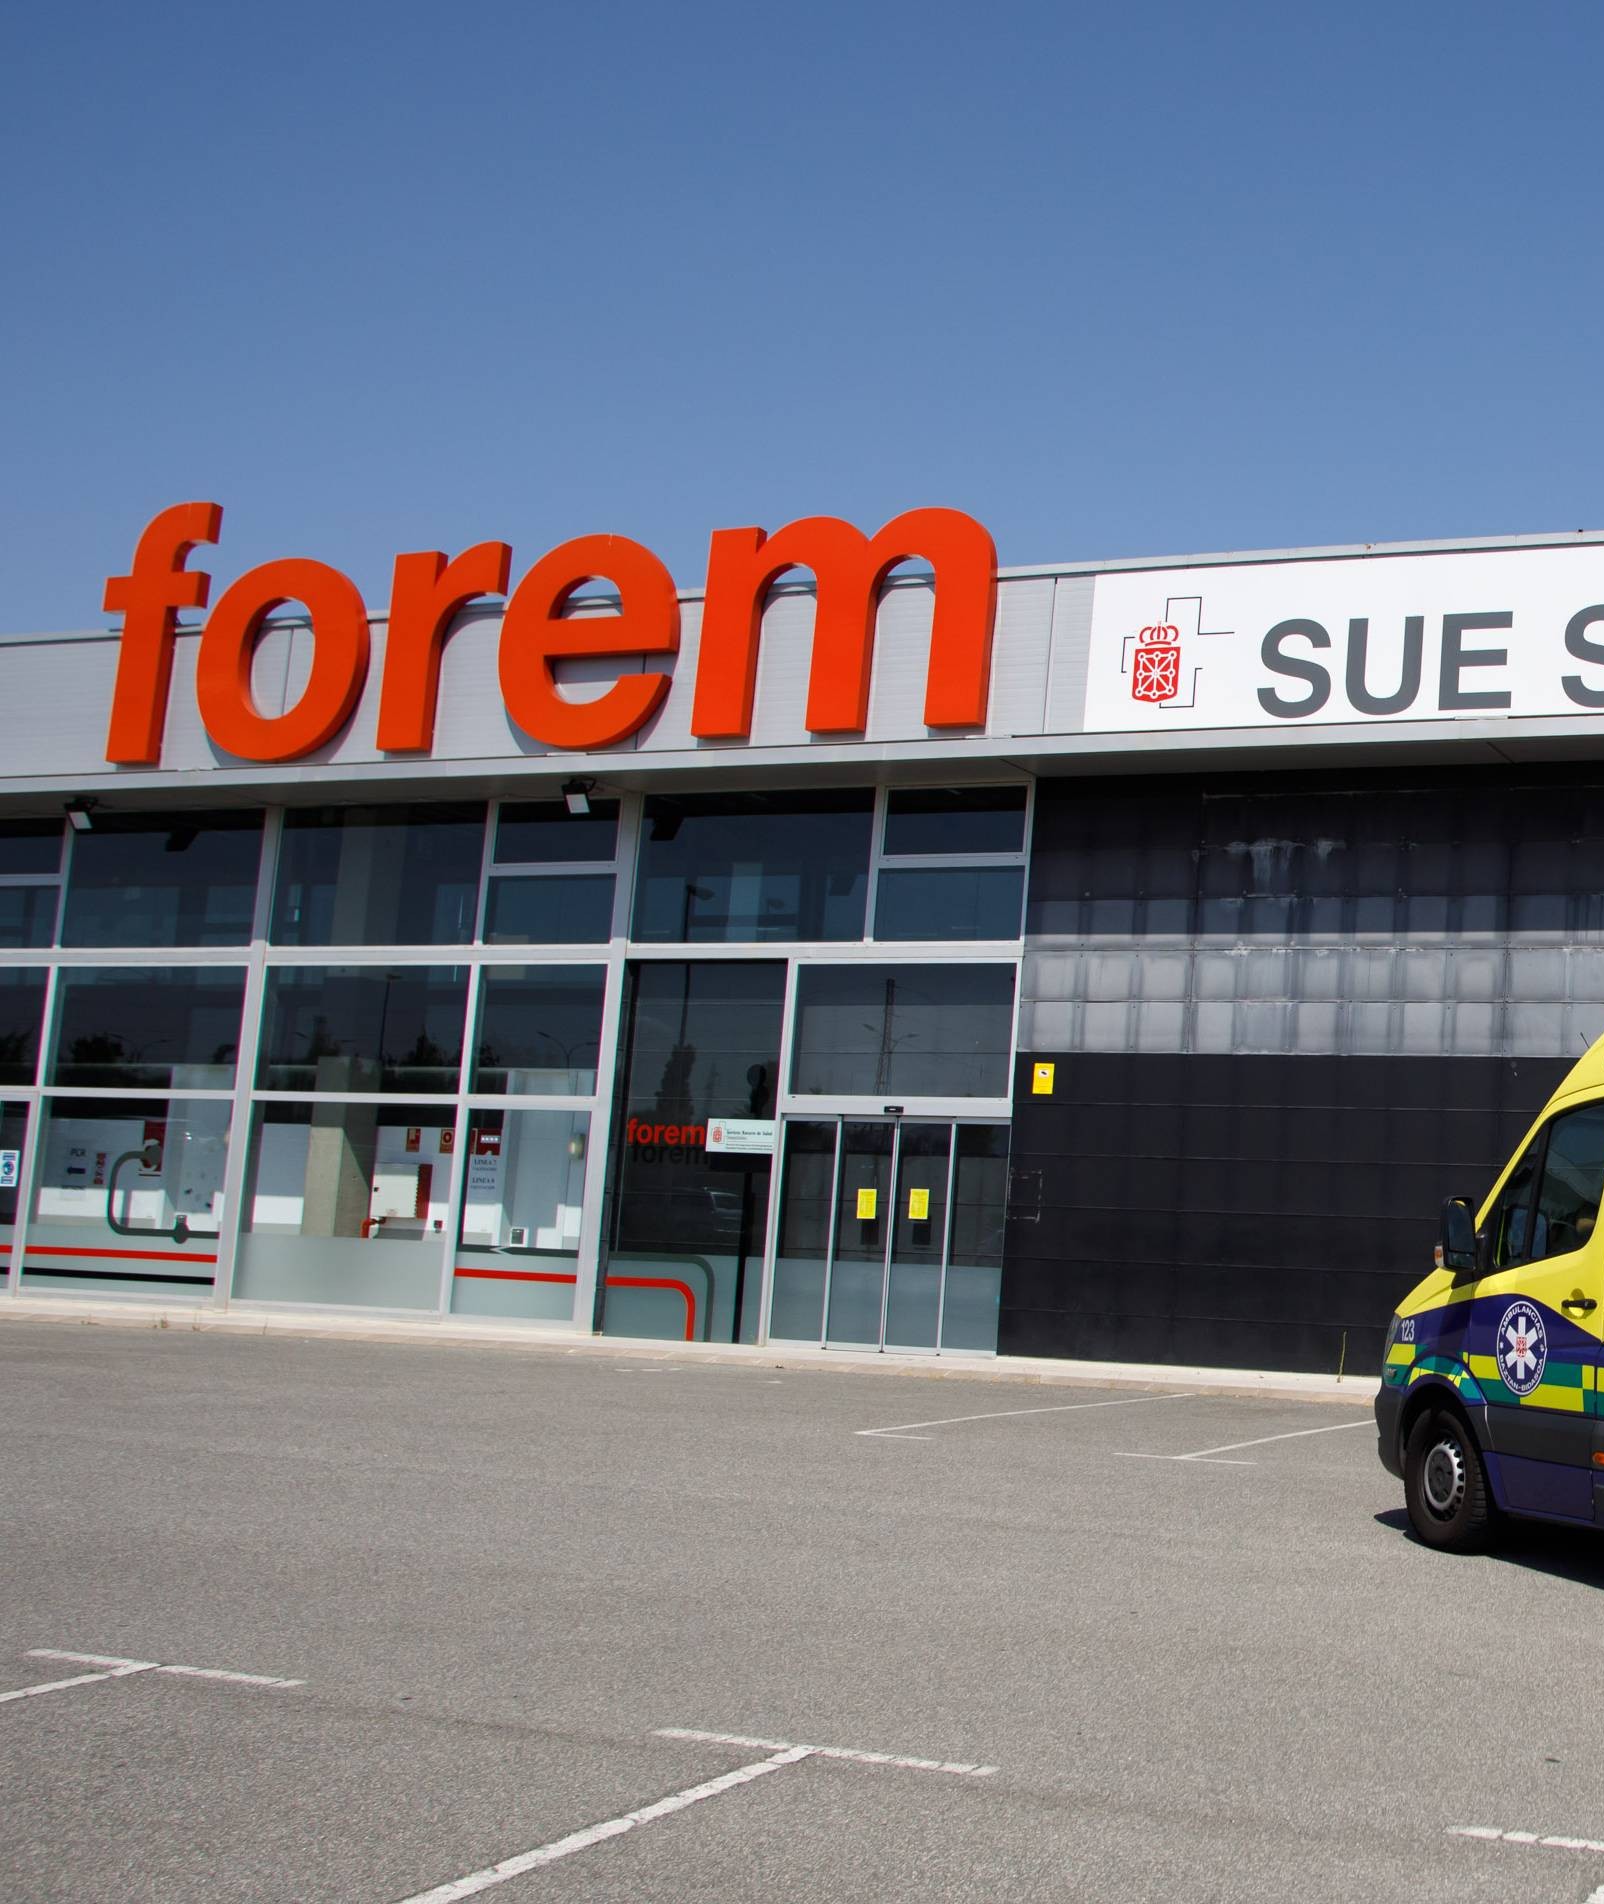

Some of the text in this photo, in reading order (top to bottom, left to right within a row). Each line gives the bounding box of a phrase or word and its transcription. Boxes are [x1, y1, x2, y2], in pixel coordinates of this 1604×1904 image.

[103, 501, 997, 764] forem
[1256, 611, 1514, 719] SUE
[627, 1118, 705, 1145] forem
[1401, 1319, 1415, 1342] 123
[1501, 1305, 1543, 1339] AMBULANCIAS
[1499, 1353, 1544, 1392] BAZTAN-BIDASOA
